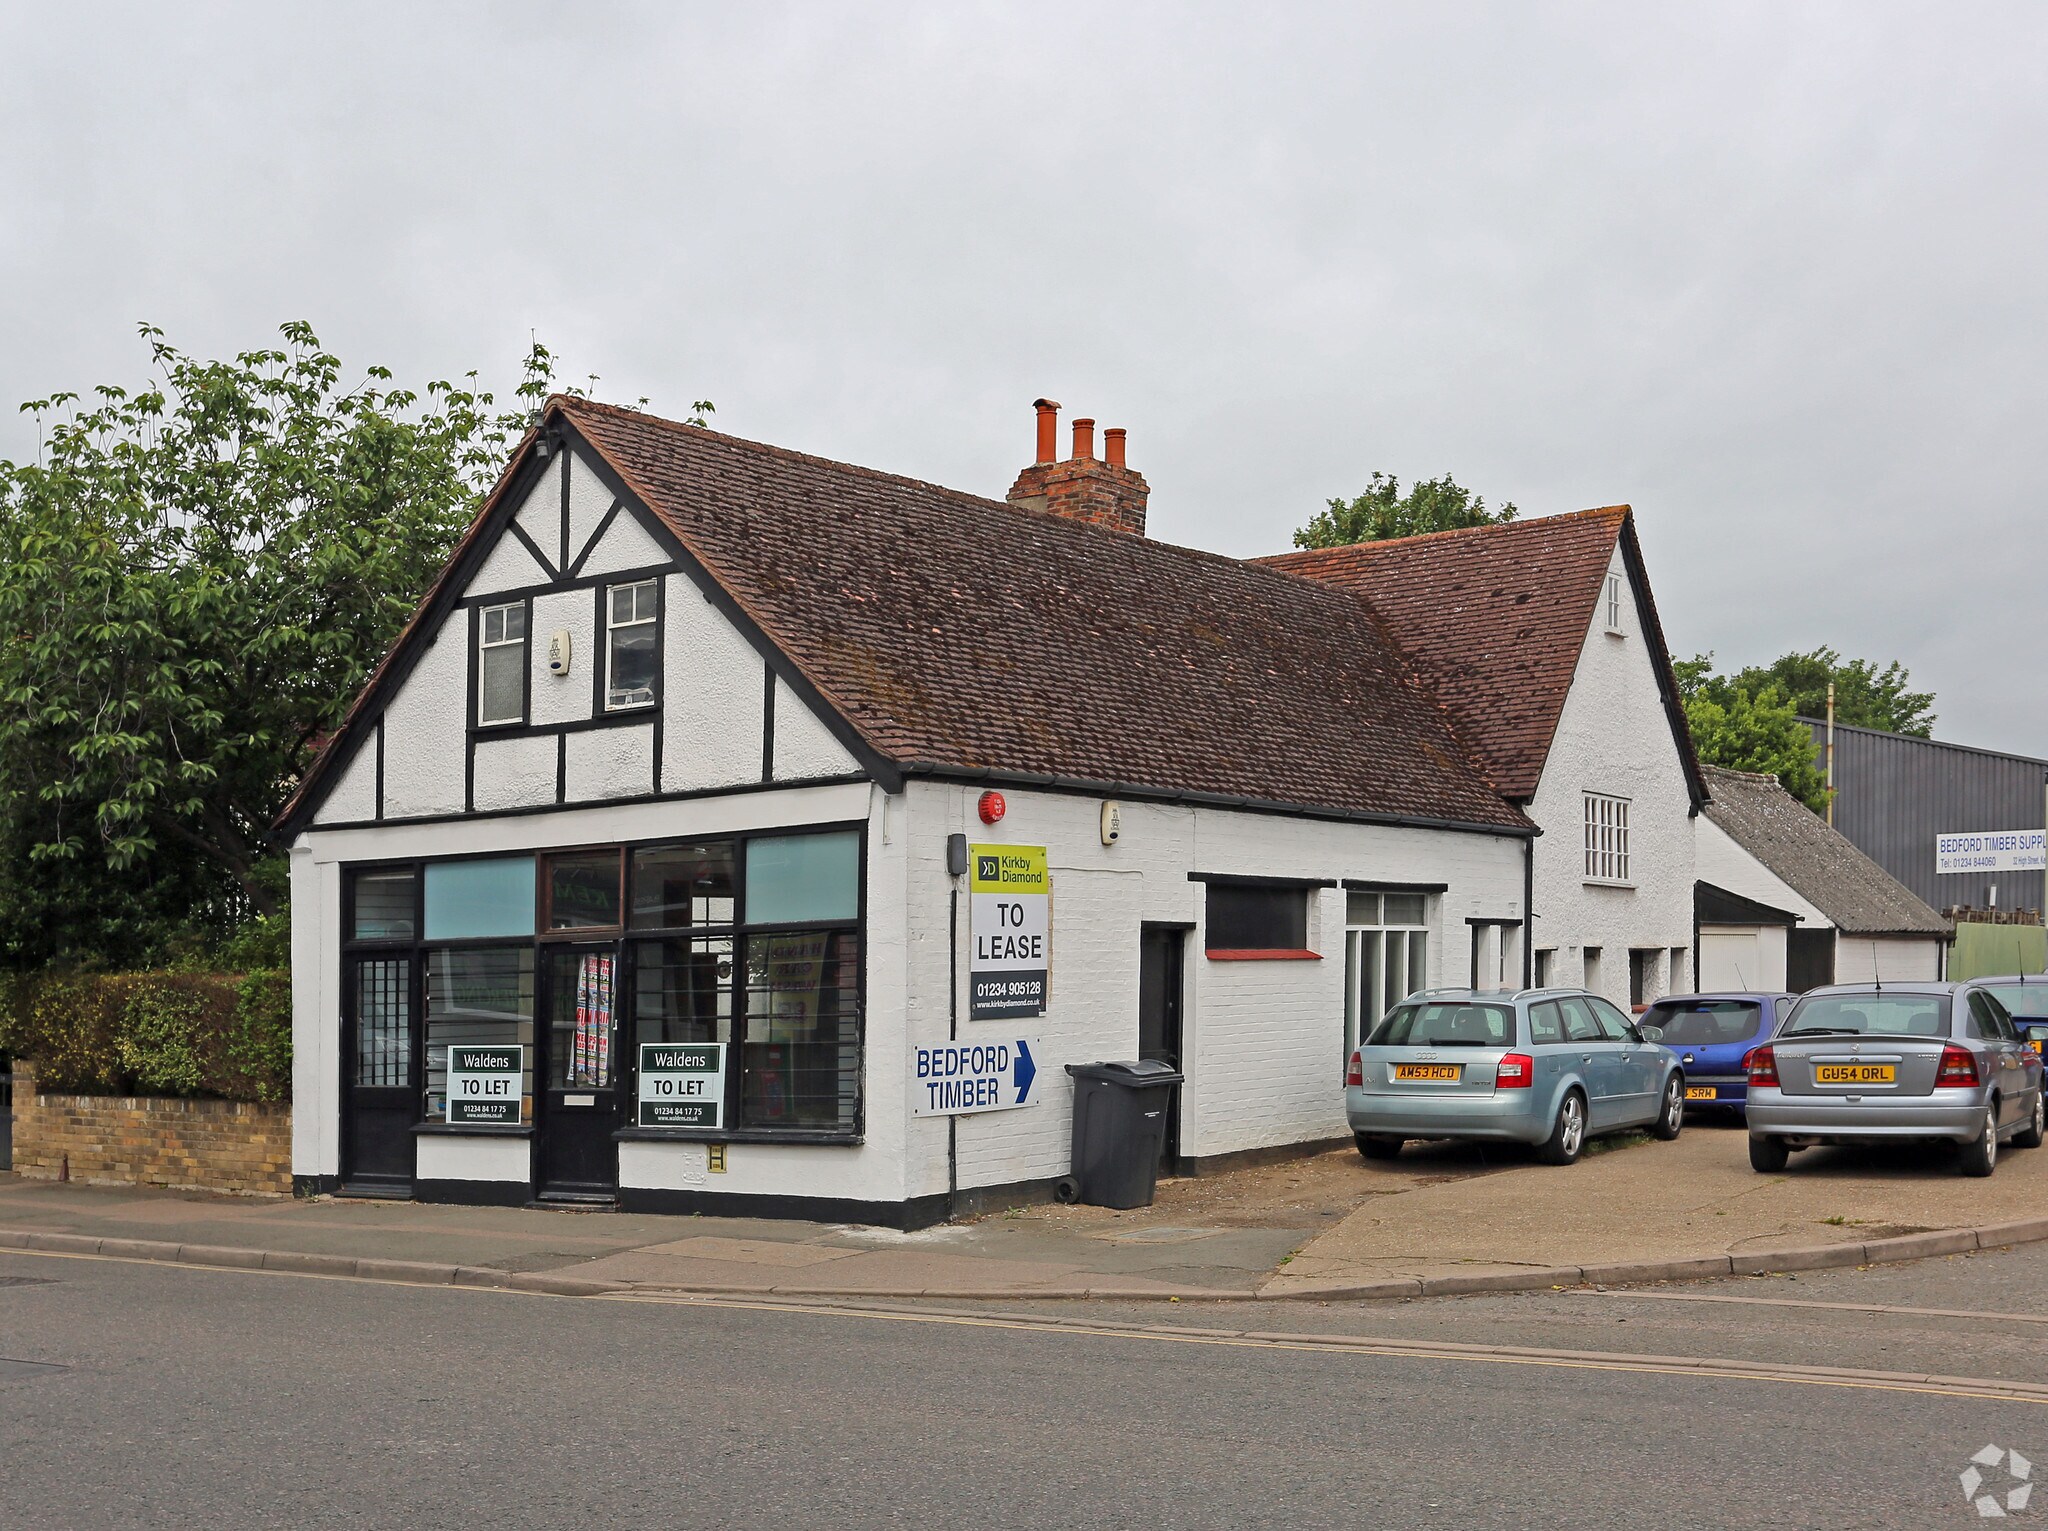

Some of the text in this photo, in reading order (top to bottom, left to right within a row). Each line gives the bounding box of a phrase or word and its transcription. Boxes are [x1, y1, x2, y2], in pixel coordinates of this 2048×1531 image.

[1940, 838, 1982, 853] BEDFORD
[1984, 836, 2017, 851] TIMBER
[1002, 856, 1030, 871] Kirkby
[1941, 857, 1996, 868] Tel: 01234 844060
[1002, 870, 1042, 883] Diamond
[997, 903, 1024, 928] TO
[978, 935, 1042, 960] LEASE
[977, 981, 1041, 997] 01234 905128
[976, 998, 1041, 1009] www.kirkbydiamond.co.uk
[463, 1053, 509, 1068] Waldens
[655, 1051, 706, 1067] Waldens
[917, 1045, 1009, 1078] BEDFORD
[1400, 1065, 1454, 1078] AM53 HCD
[1822, 1067, 1888, 1080] GU54 ORL
[462, 1079, 510, 1095] TO LET
[654, 1080, 704, 1095] TO LET
[926, 1077, 999, 1110] TIMBER
[490, 1105, 497, 1113] 17
[499, 1105, 506, 1113] 75
[654, 1107, 674, 1115] 01234
[675, 1107, 683, 1115] 84
